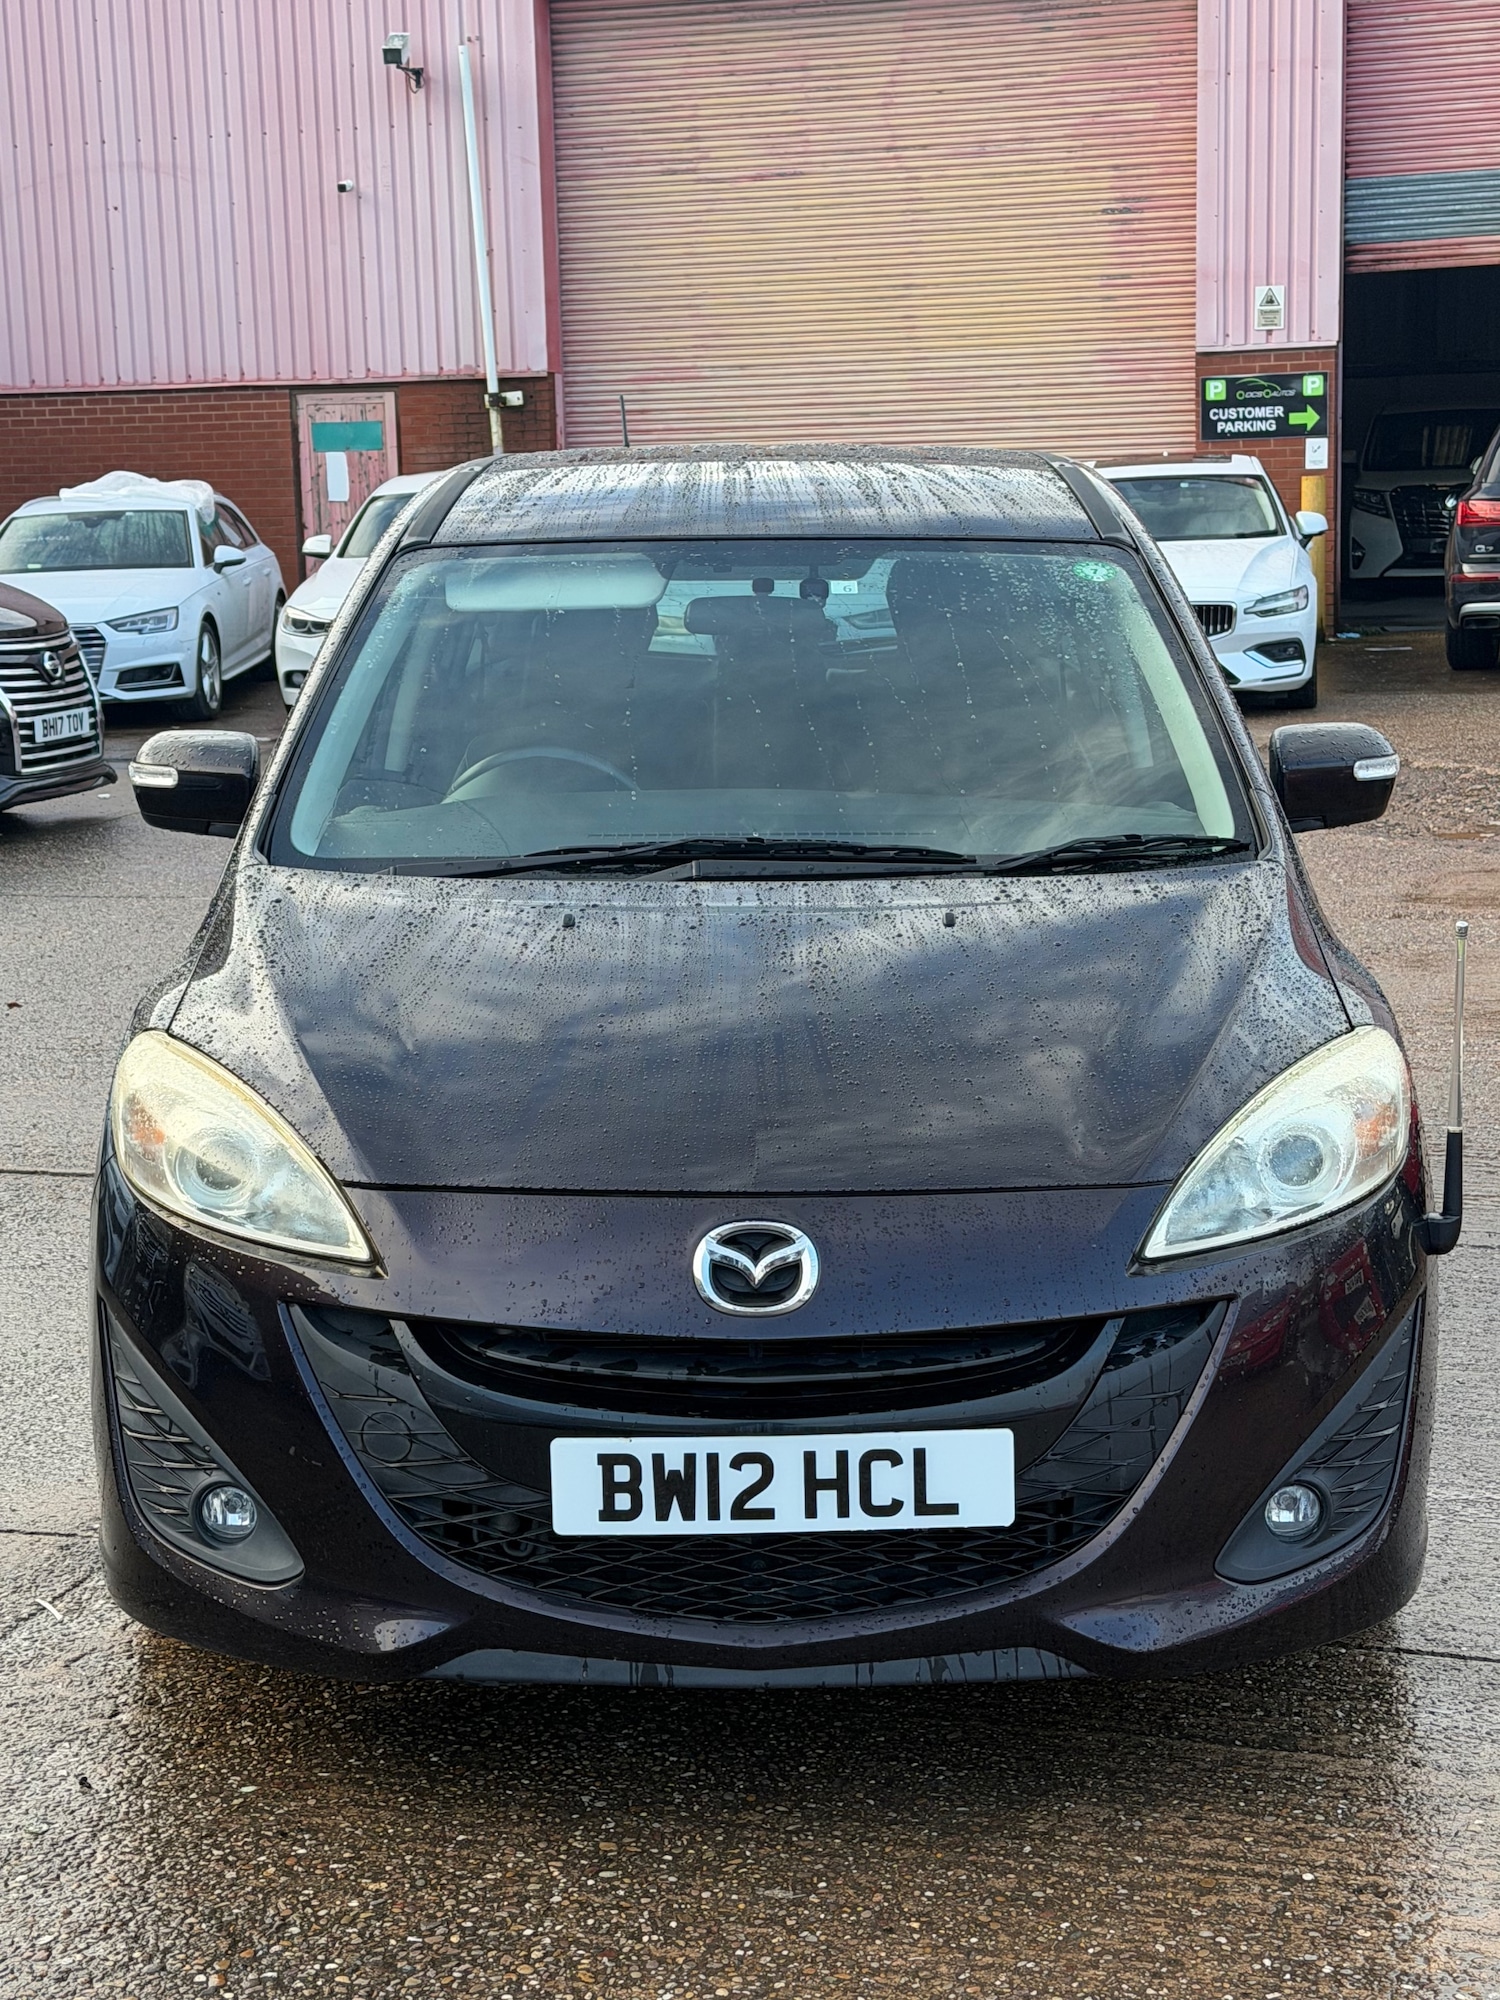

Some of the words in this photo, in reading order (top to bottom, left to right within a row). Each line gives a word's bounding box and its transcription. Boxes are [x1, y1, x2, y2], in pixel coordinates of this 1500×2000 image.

[1210, 383, 1223, 399] P
[1307, 378, 1320, 393] P
[1209, 406, 1285, 420] CUSTOMER
[1217, 420, 1277, 433] PARKING
[1475, 544, 1494, 553] Q7
[42, 716, 63, 738] BH17
[67, 712, 84, 733] TOV
[597, 1452, 775, 1522] BW12
[803, 1448, 960, 1519] HCL
